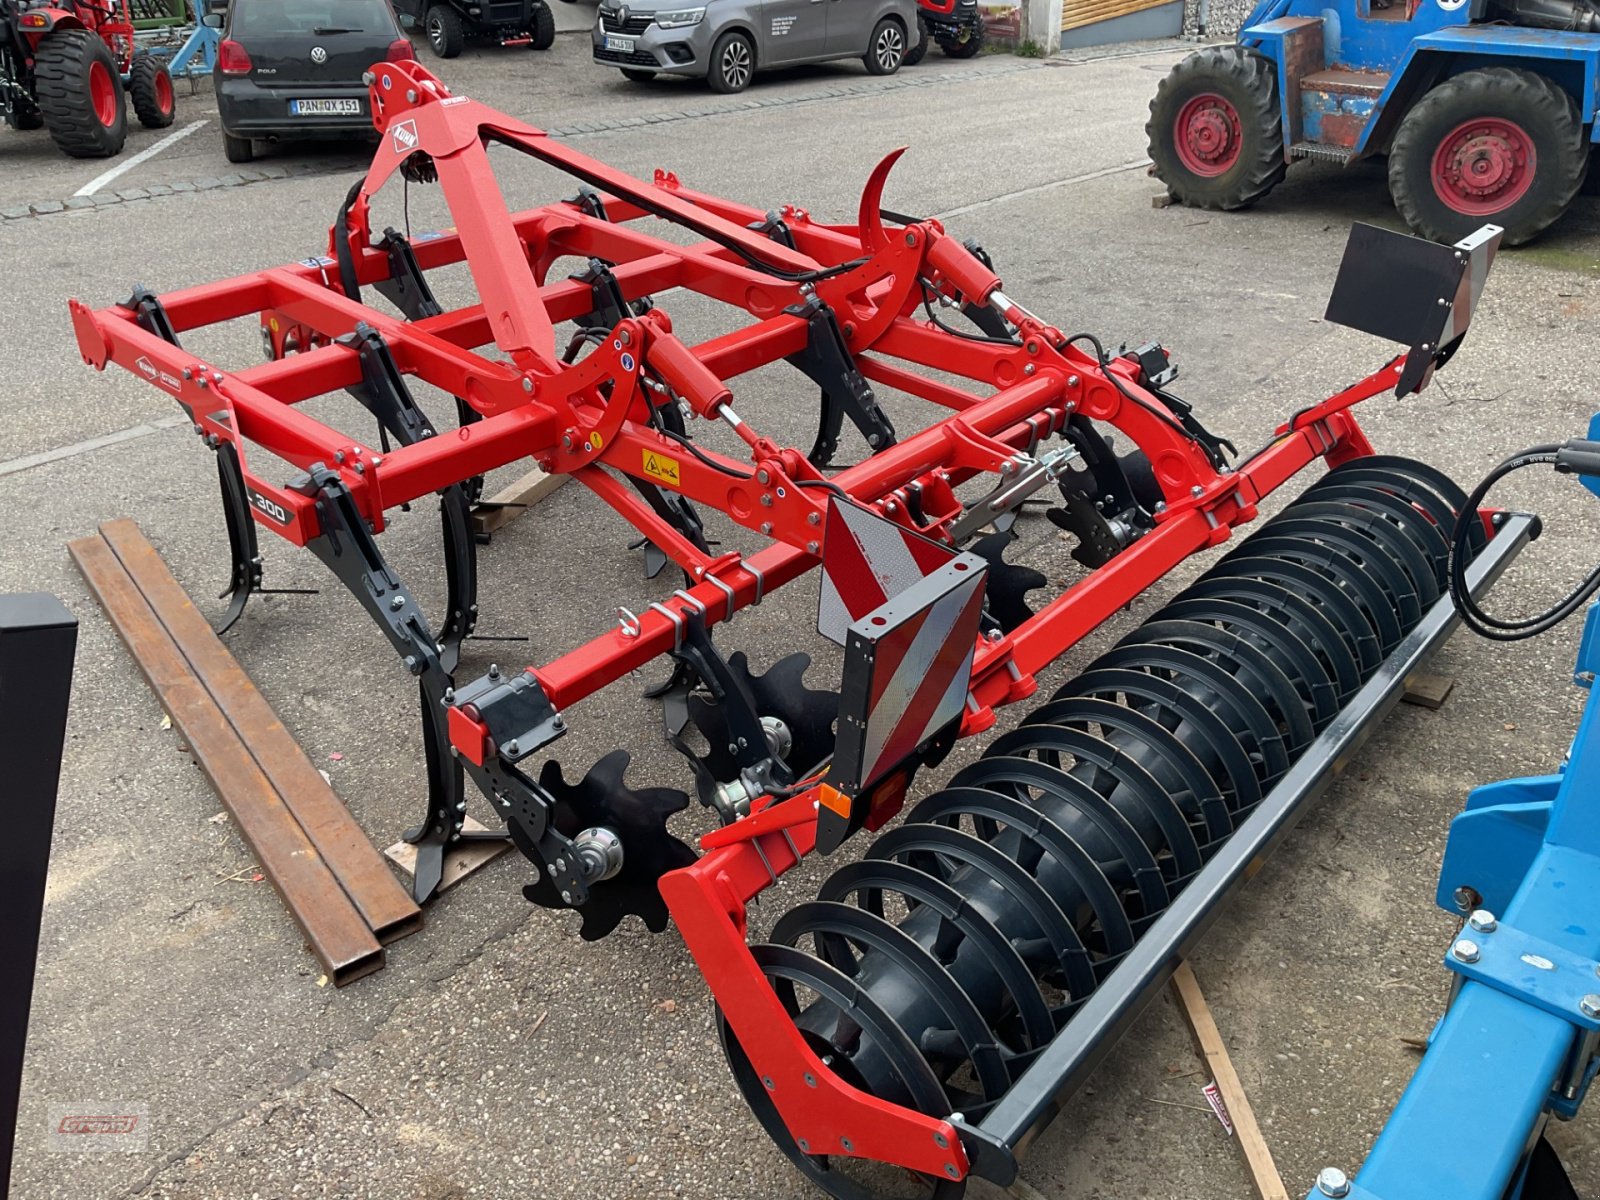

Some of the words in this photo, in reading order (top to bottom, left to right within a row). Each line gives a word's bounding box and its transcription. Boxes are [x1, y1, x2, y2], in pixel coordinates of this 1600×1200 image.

[298, 100, 319, 112] PAN
[324, 100, 338, 111] QX
[339, 100, 358, 111] 151
[394, 125, 416, 147] KUHN
[255, 493, 286, 522] 300
